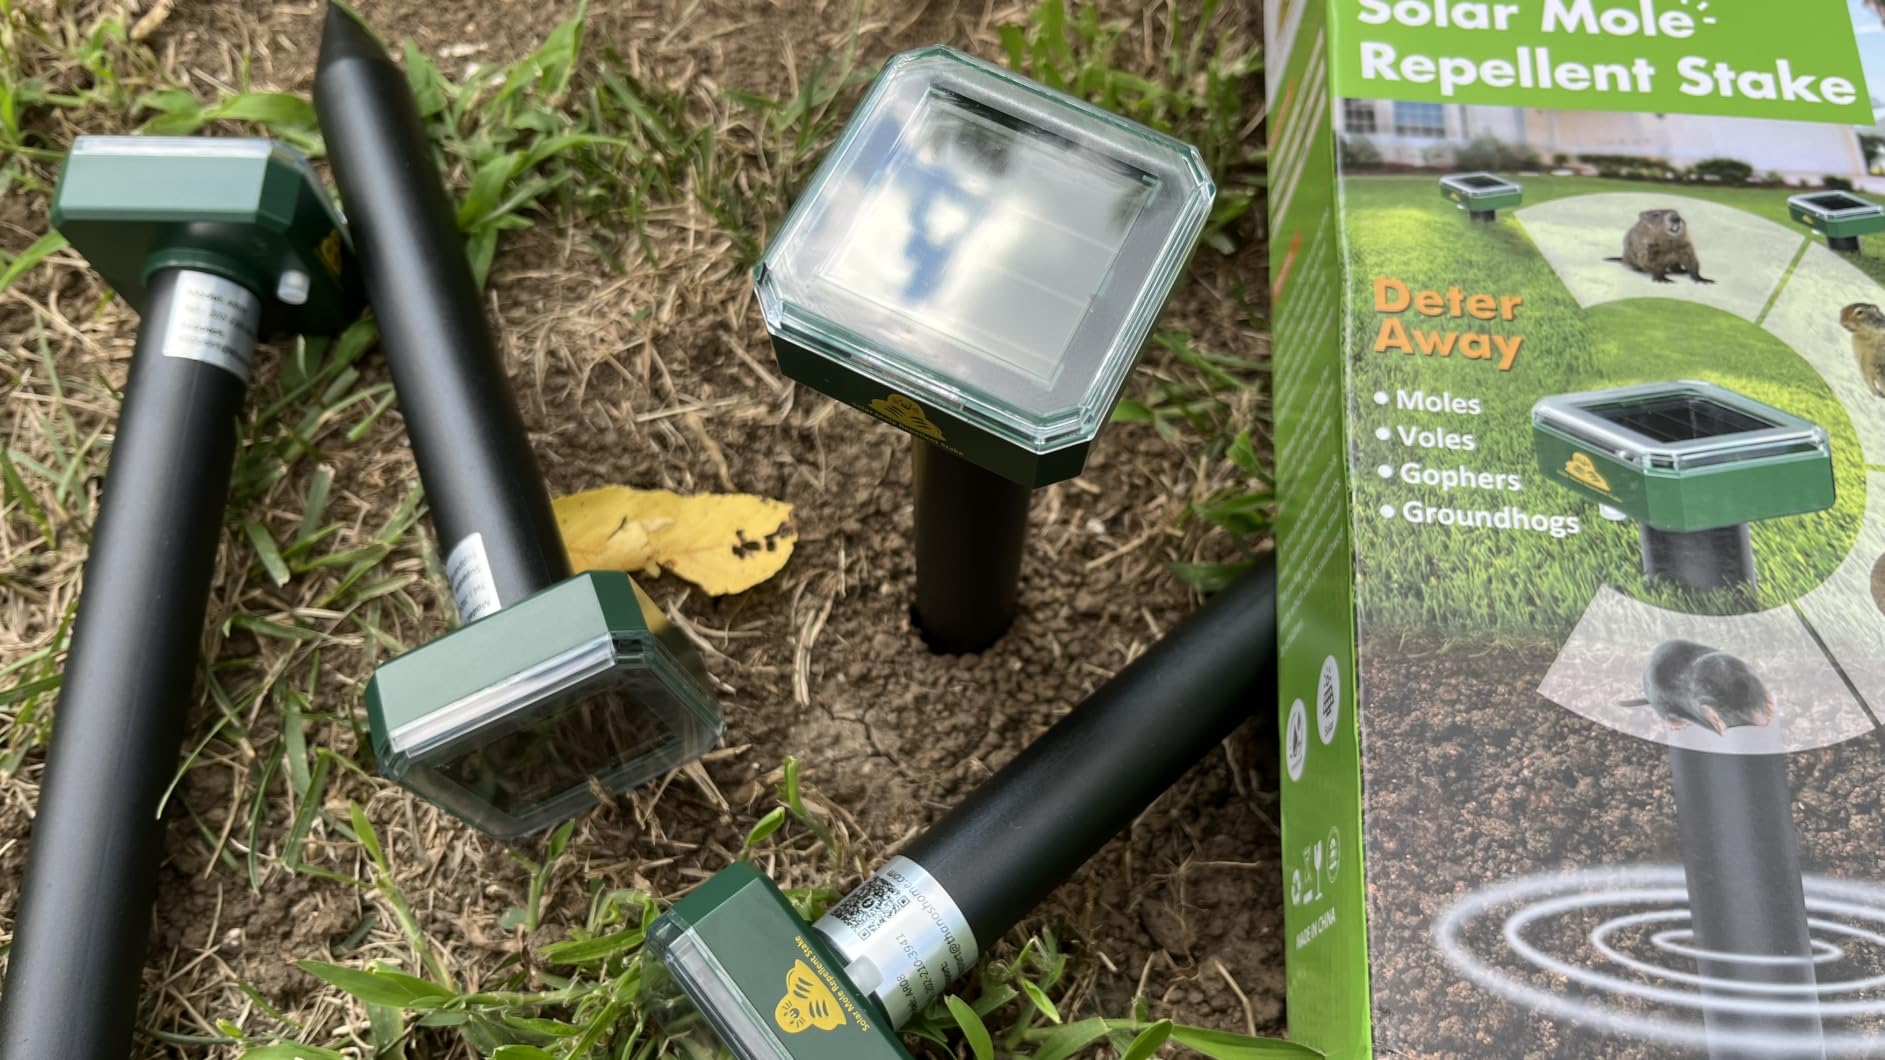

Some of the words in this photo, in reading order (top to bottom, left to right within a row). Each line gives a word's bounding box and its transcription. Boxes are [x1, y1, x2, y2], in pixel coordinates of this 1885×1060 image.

[1358, 0, 1519, 30] Solar
[1541, 0, 1695, 38] Mole
[1360, 41, 1656, 96] Repellent
[1677, 56, 1857, 105] Stake
[1374, 276, 1523, 321] Deter
[1374, 316, 1524, 372] Away
[1397, 389, 1482, 415] Moles
[1397, 425, 1476, 450] Voles
[1400, 462, 1522, 491] Gophers
[1403, 501, 1581, 538] Groundhogs
[1296, 925, 1311, 951] MADE
[1310, 919, 1318, 938] IN
[1318, 906, 1336, 933] CHINA
[795, 935, 813, 958] Stake
[811, 955, 839, 992] Repellent
[896, 974, 914, 998] AR08
[837, 990, 855, 1012] Mole
[852, 1010, 870, 1032] Solar
